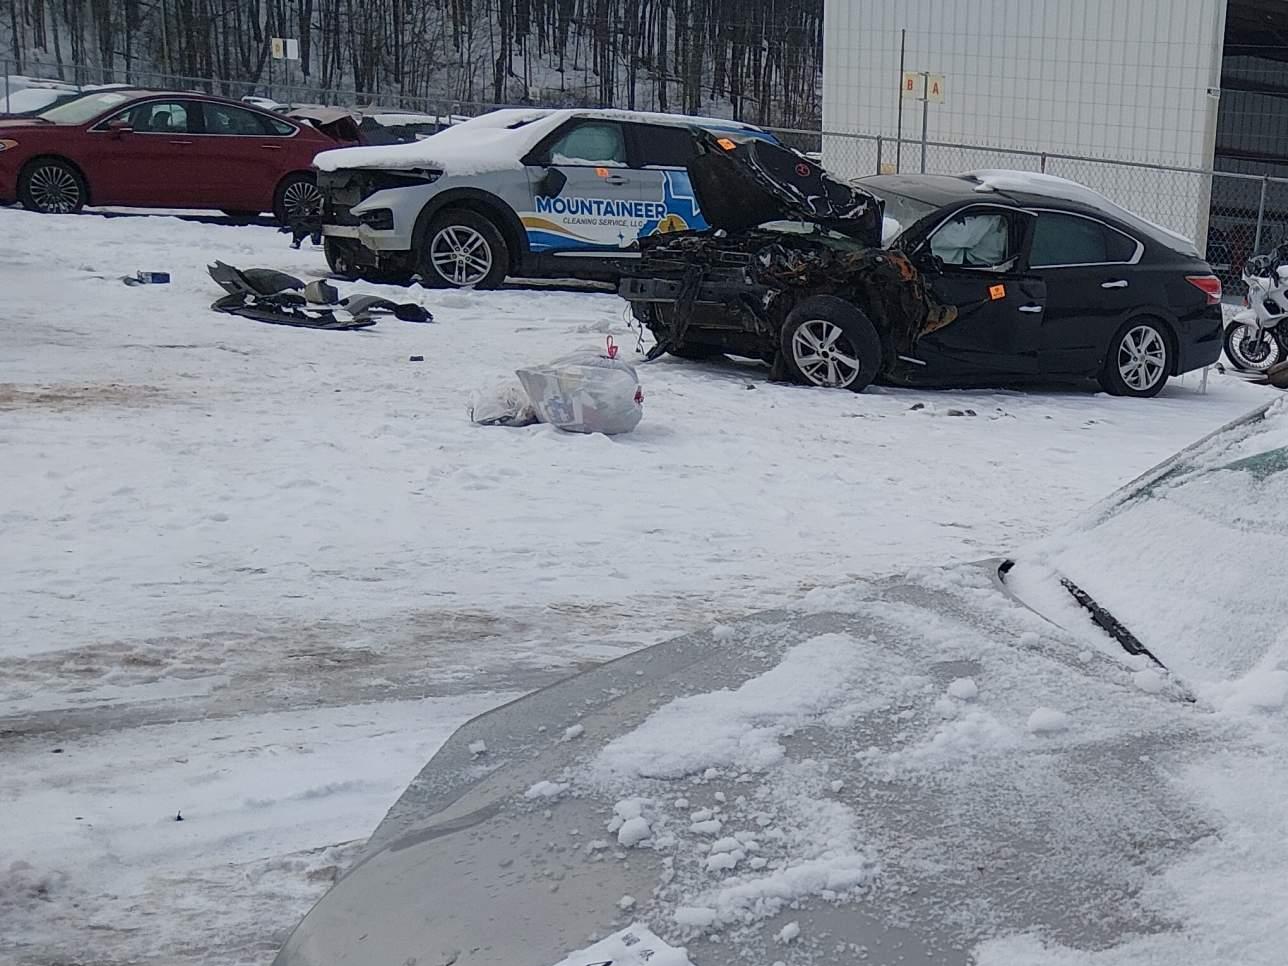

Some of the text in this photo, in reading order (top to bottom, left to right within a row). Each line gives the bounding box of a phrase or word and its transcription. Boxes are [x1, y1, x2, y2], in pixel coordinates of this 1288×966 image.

[932, 82, 940, 97] A
[536, 197, 667, 219] MOUNTAINEER
[562, 217, 597, 226] CLEANING
[630, 220, 643, 228] LLC
